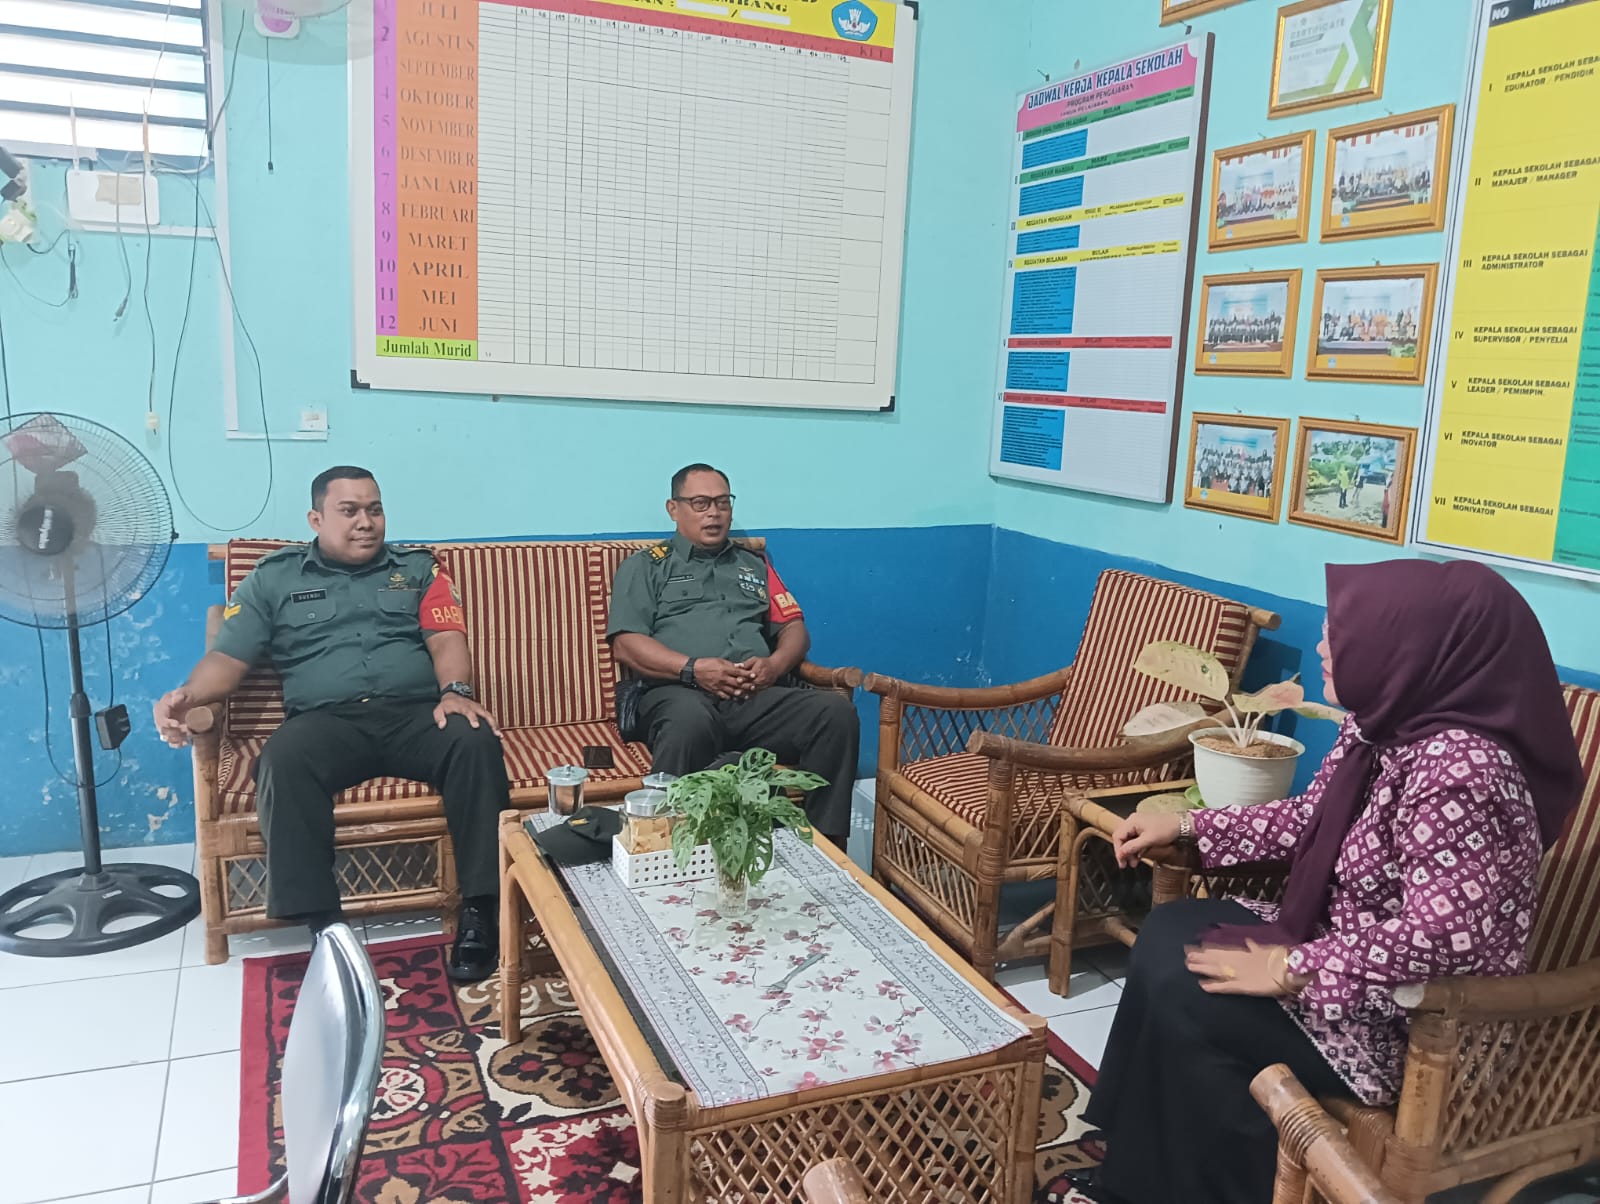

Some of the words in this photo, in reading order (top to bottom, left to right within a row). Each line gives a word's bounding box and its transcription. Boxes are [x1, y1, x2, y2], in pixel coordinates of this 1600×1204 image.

[1492, 7, 1510, 20] NO
[381, 26, 390, 41] 2
[403, 29, 475, 51] AGUSTUS
[400, 58, 475, 81] SEPTEMBER
[1506, 69, 1536, 82] KEPALA
[1538, 60, 1575, 75] SEKOLAH
[1028, 89, 1061, 109] JADWAL
[1063, 77, 1093, 98] KERJA
[1096, 64, 1133, 88] KEPALA
[1135, 48, 1183, 76] SEKOLAH
[1504, 78, 1546, 93] EDUKATOR
[1554, 68, 1594, 82] PENDIDIK
[400, 87, 475, 110] OKTOBER
[401, 116, 475, 139] NOVEMBER
[400, 145, 475, 168] DESEMBER
[1493, 167, 1522, 177] KEPALA
[1524, 162, 1561, 173] SEKOLAH
[401, 173, 474, 195] JANUARI
[1475, 177, 1481, 186] II
[1491, 176, 1528, 188] MANAJER
[1536, 170, 1578, 182] MANAGER
[400, 202, 474, 224] FEBRUARI
[382, 231, 391, 244] 9
[408, 232, 469, 251] MARET
[1463, 259, 1472, 268] III
[1482, 253, 1511, 262] KEPALA
[1513, 251, 1549, 260] SEKOLAH
[1551, 249, 1588, 259] SEBAGAI
[380, 258, 396, 273] 10
[408, 261, 469, 279] APRIL
[1481, 260, 1544, 270] ADMINISTRATOR
[381, 287, 394, 301] 11
[422, 289, 455, 305] MEI
[380, 314, 396, 330] 12
[418, 317, 457, 333] JUNI
[1473, 326, 1502, 334] KEPALA
[1504, 326, 1540, 334] SEKOLAH
[1542, 326, 1578, 334] SEBAGAI
[1454, 331, 1464, 339] IV
[1473, 335, 1521, 343] SUPERVISOR
[1529, 336, 1568, 344] PENYELIA
[383, 339, 430, 355] Jumlah
[433, 341, 472, 357] Murid
[1451, 380, 1457, 389] V
[1467, 386, 1496, 394] LEADER
[1503, 387, 1543, 396] PEMIMPIN
[1468, 377, 1496, 385] KEPALA
[1498, 378, 1533, 387] SEKOLAH
[1535, 380, 1570, 389] SEBAGAI
[1444, 432, 1453, 441] VI
[1461, 439, 1497, 448] INOVATOR
[1462, 430, 1490, 439] KEPALA
[1491, 433, 1526, 443] SEKOLAH
[1528, 436, 1563, 446] SEBAGAI
[1434, 496, 1446, 505] VII
[1453, 496, 1481, 506] KEPALA
[1483, 499, 1518, 511] SEKOLAH
[1519, 505, 1554, 516] SEBAGAI
[1452, 504, 1496, 516] MONIVATOR
